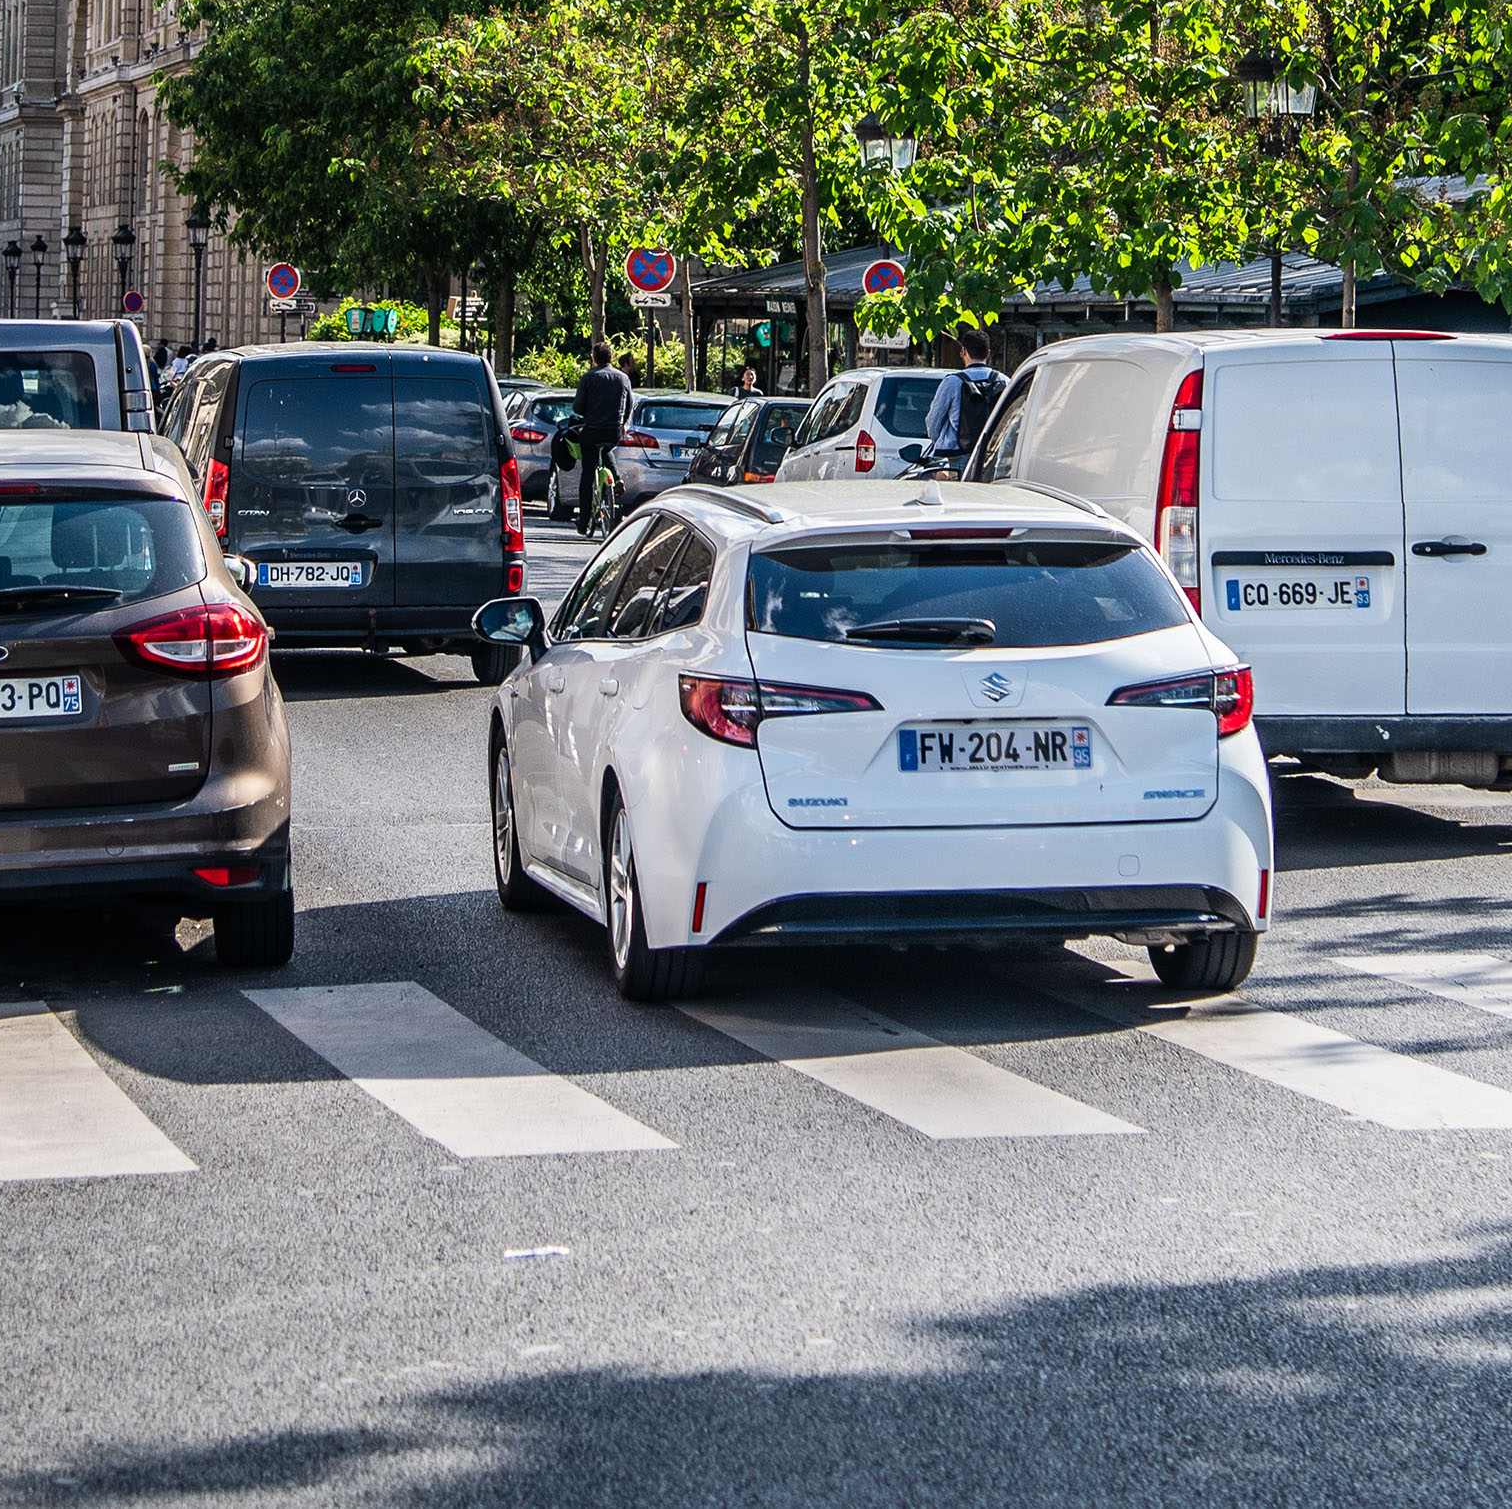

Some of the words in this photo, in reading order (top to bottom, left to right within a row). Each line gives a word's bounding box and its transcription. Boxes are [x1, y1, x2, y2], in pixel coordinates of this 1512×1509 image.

[1264, 552, 1345, 565] Mercedes-Benz
[270, 566, 350, 582] DH-782-JQ
[1243, 582, 1353, 606] CQ-669-JE
[1357, 593, 1370, 605] 93
[64, 696, 80, 713] 75
[919, 731, 1068, 764] FW-204-NR
[1074, 748, 1090, 765] 95
[787, 797, 849, 808] SUZUKI
